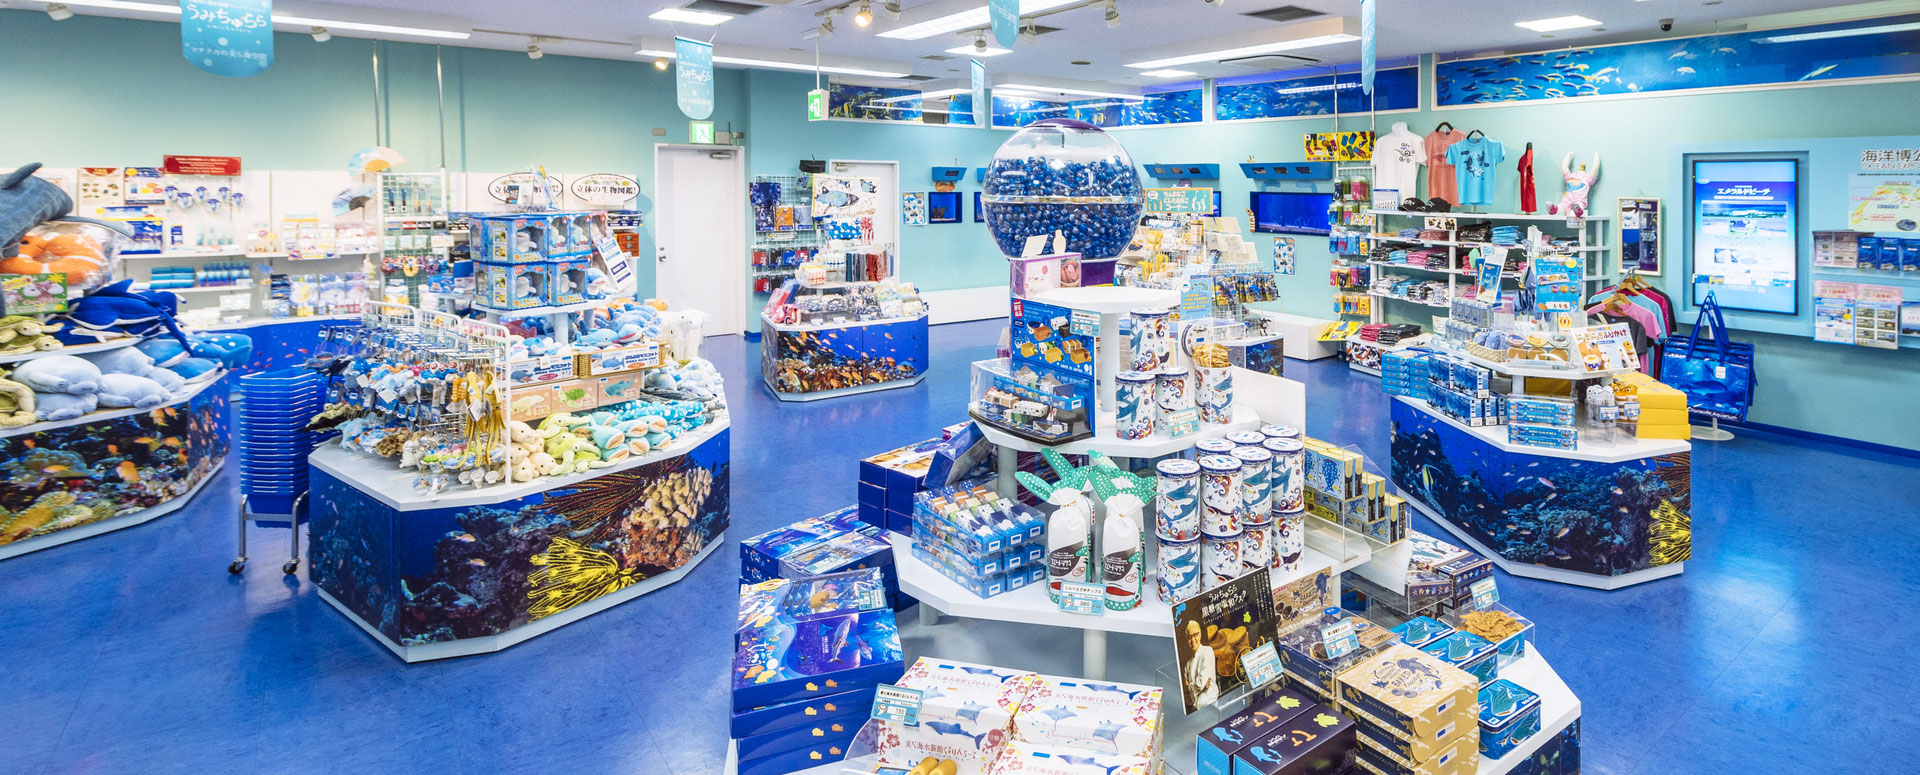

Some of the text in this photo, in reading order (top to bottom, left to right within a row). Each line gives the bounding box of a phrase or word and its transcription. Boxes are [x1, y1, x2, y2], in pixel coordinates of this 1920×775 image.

[186, 3, 267, 29] うみちゅらら
[1209, 584, 1238, 603] うみちゅらら
